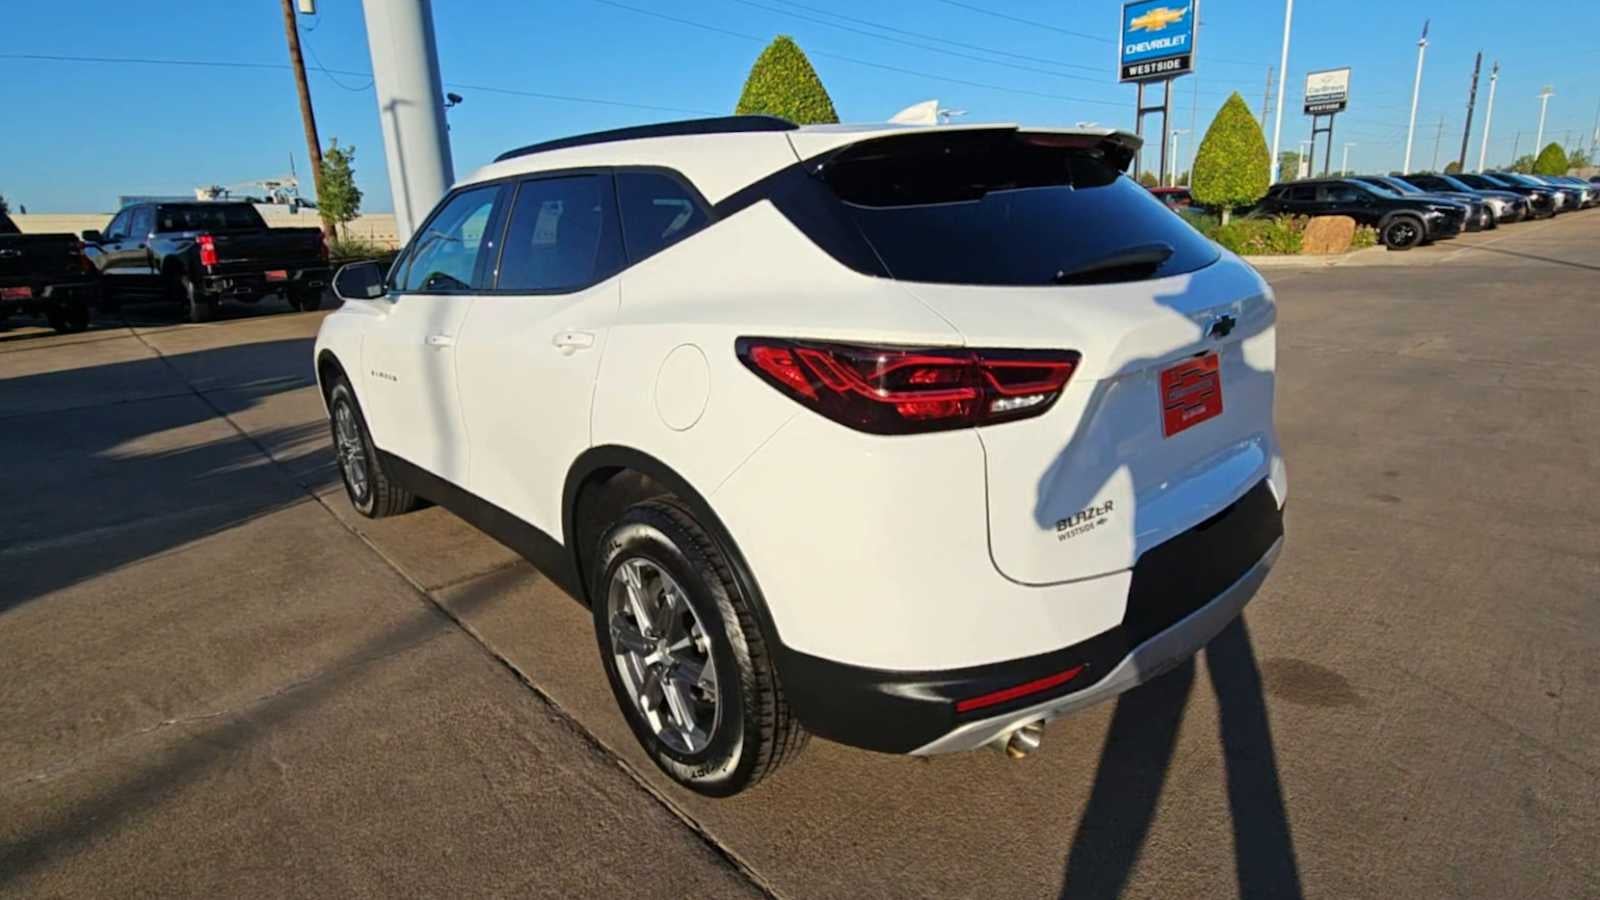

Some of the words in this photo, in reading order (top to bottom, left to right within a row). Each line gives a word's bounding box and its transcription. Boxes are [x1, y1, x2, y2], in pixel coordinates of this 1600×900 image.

[1126, 35, 1186, 55] CHEVROLET
[1129, 58, 1181, 76] WESTSIDE
[1056, 500, 1113, 531] BLAZER
[1057, 522, 1095, 542] WESTSIDE
